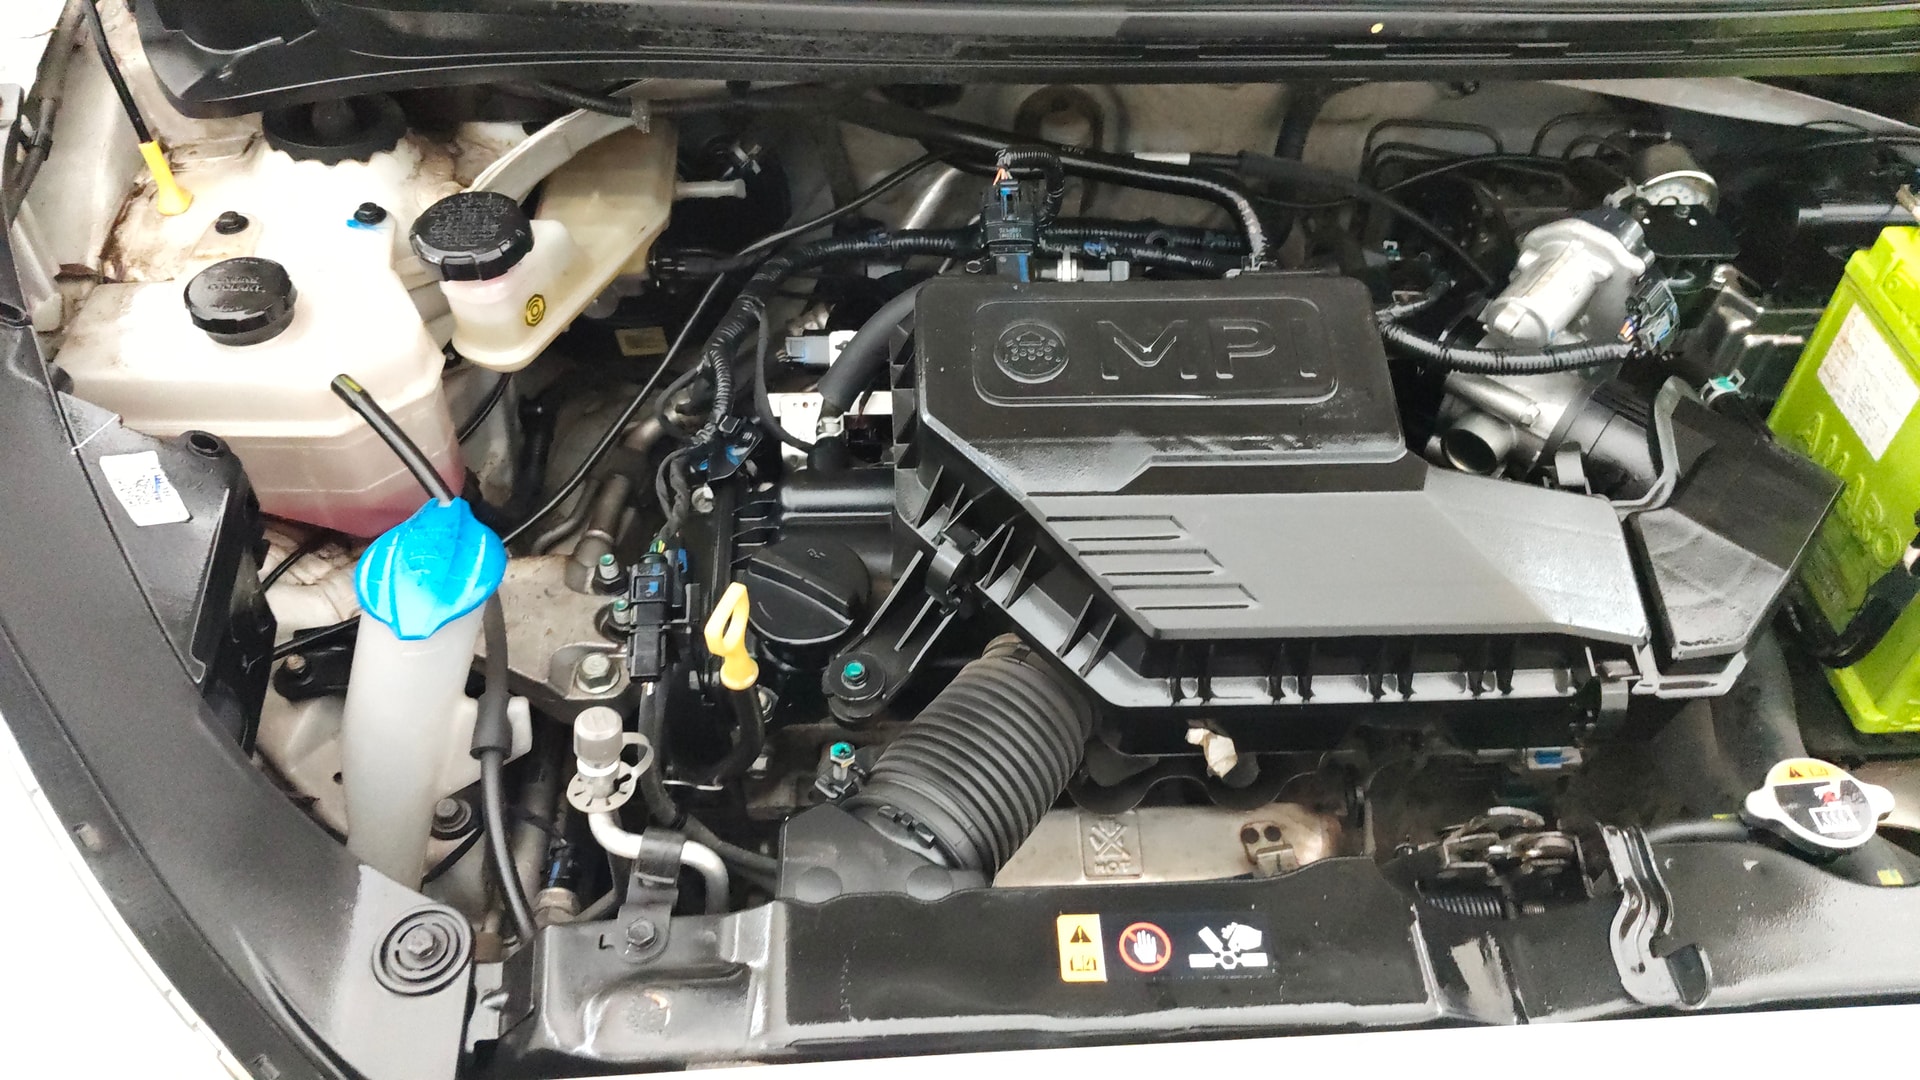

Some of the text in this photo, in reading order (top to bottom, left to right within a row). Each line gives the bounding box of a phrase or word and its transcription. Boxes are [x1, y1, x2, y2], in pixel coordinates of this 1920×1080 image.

[1096, 318, 1318, 380] MPI
[1796, 411, 1902, 568] AMARO
[1094, 859, 1131, 874] HOT
